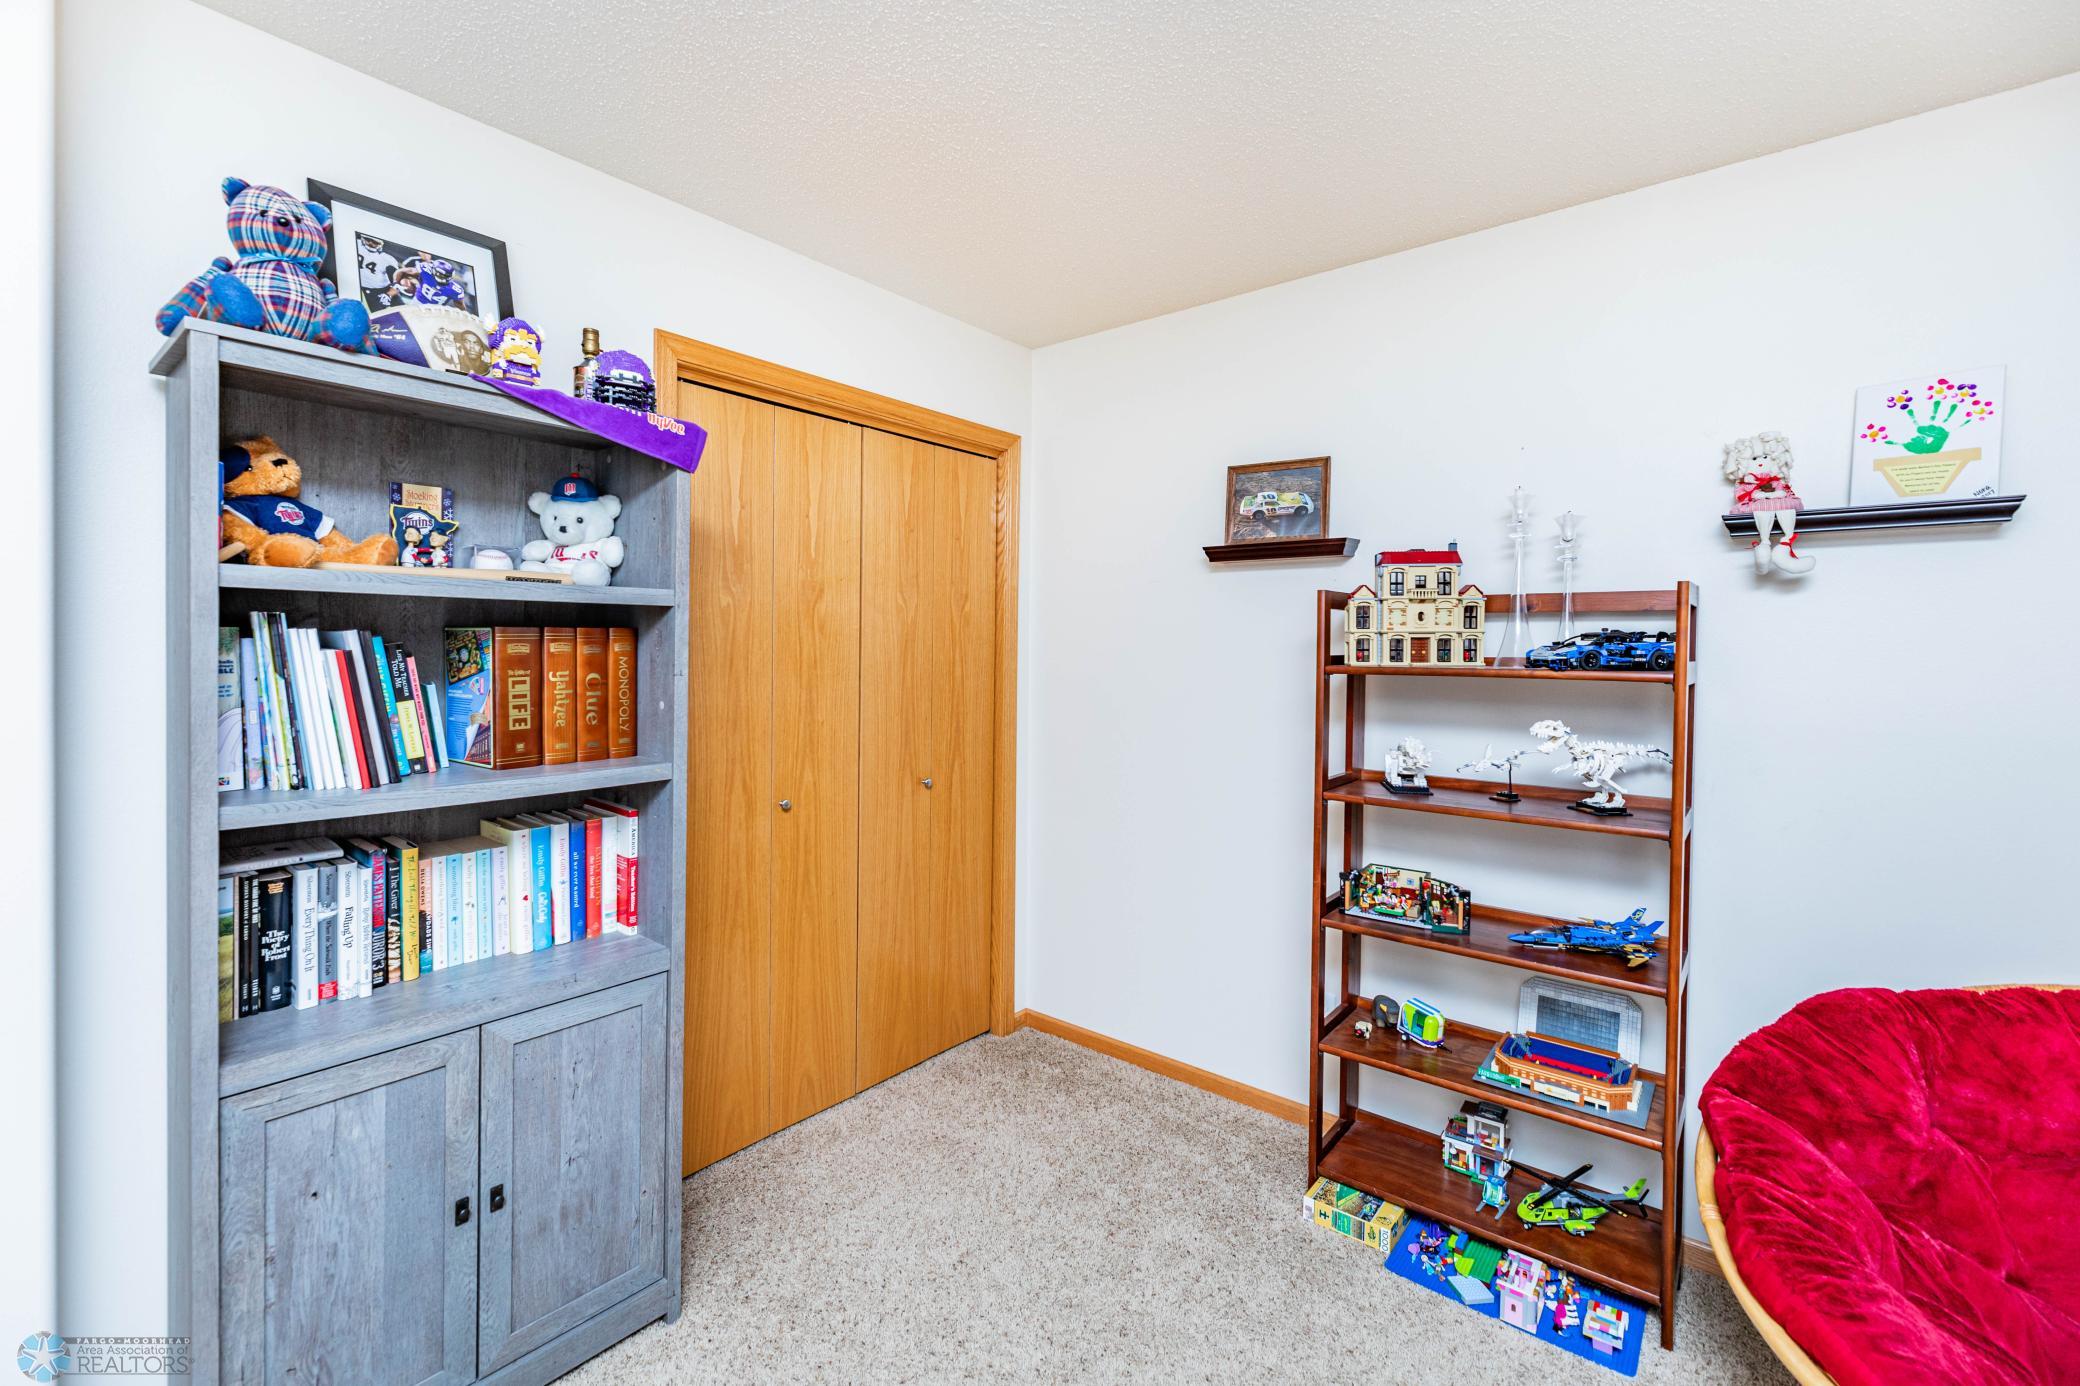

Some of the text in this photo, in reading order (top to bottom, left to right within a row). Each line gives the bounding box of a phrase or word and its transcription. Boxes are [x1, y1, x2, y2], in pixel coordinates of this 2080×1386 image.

[422, 285, 448, 304] 84
[400, 515, 434, 528] Twins
[510, 677, 530, 730] LIFE
[585, 672, 602, 725] Clue
[618, 656, 631, 731] MONOPOLY
[391, 874, 399, 910] The Giver
[303, 908, 315, 929] Every
[341, 906, 354, 948] Falling Up
[261, 935, 289, 944] Poetry
[271, 942, 280, 950] of
[303, 928, 315, 953] Thing
[372, 931, 385, 960] JUROR
[261, 946, 290, 957] Robert
[264, 953, 287, 962] Frost
[304, 954, 314, 964] On
